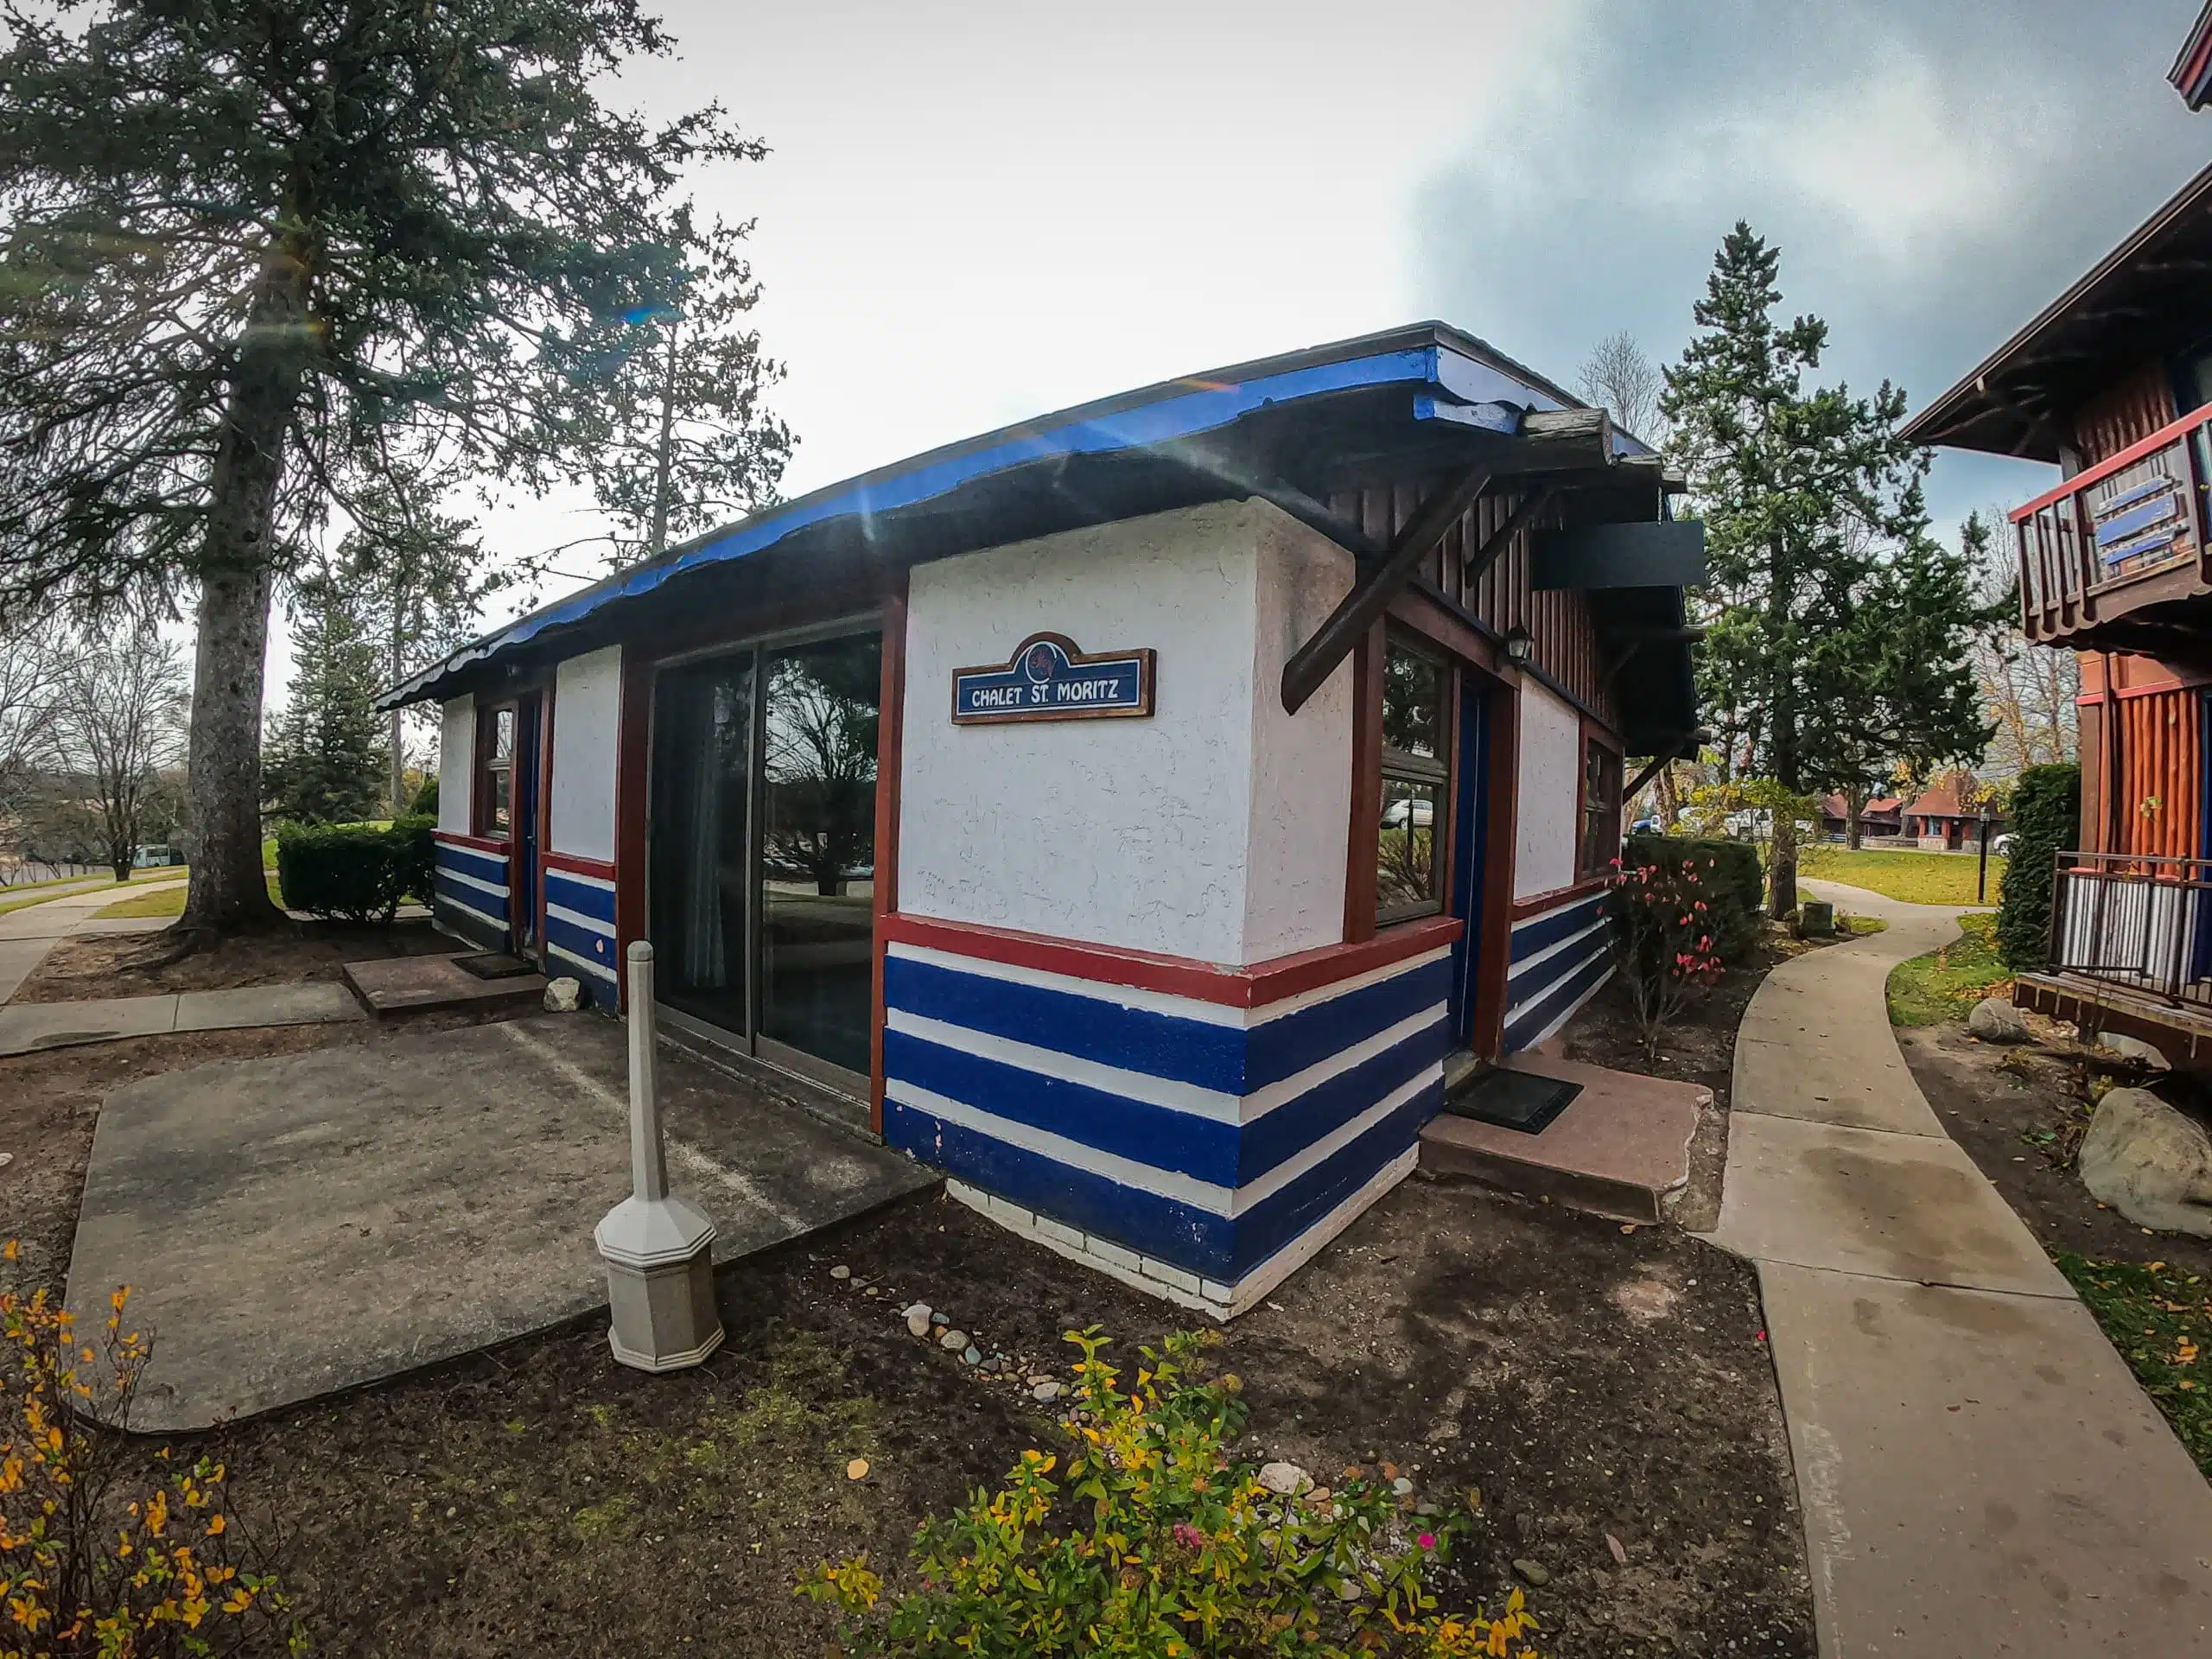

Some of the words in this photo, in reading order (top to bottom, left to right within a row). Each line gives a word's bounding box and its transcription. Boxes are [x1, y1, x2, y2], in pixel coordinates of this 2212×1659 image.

[972, 687, 1022, 707] CHALET
[1031, 683, 1049, 703] ST.
[1058, 679, 1118, 702] MORITZ
